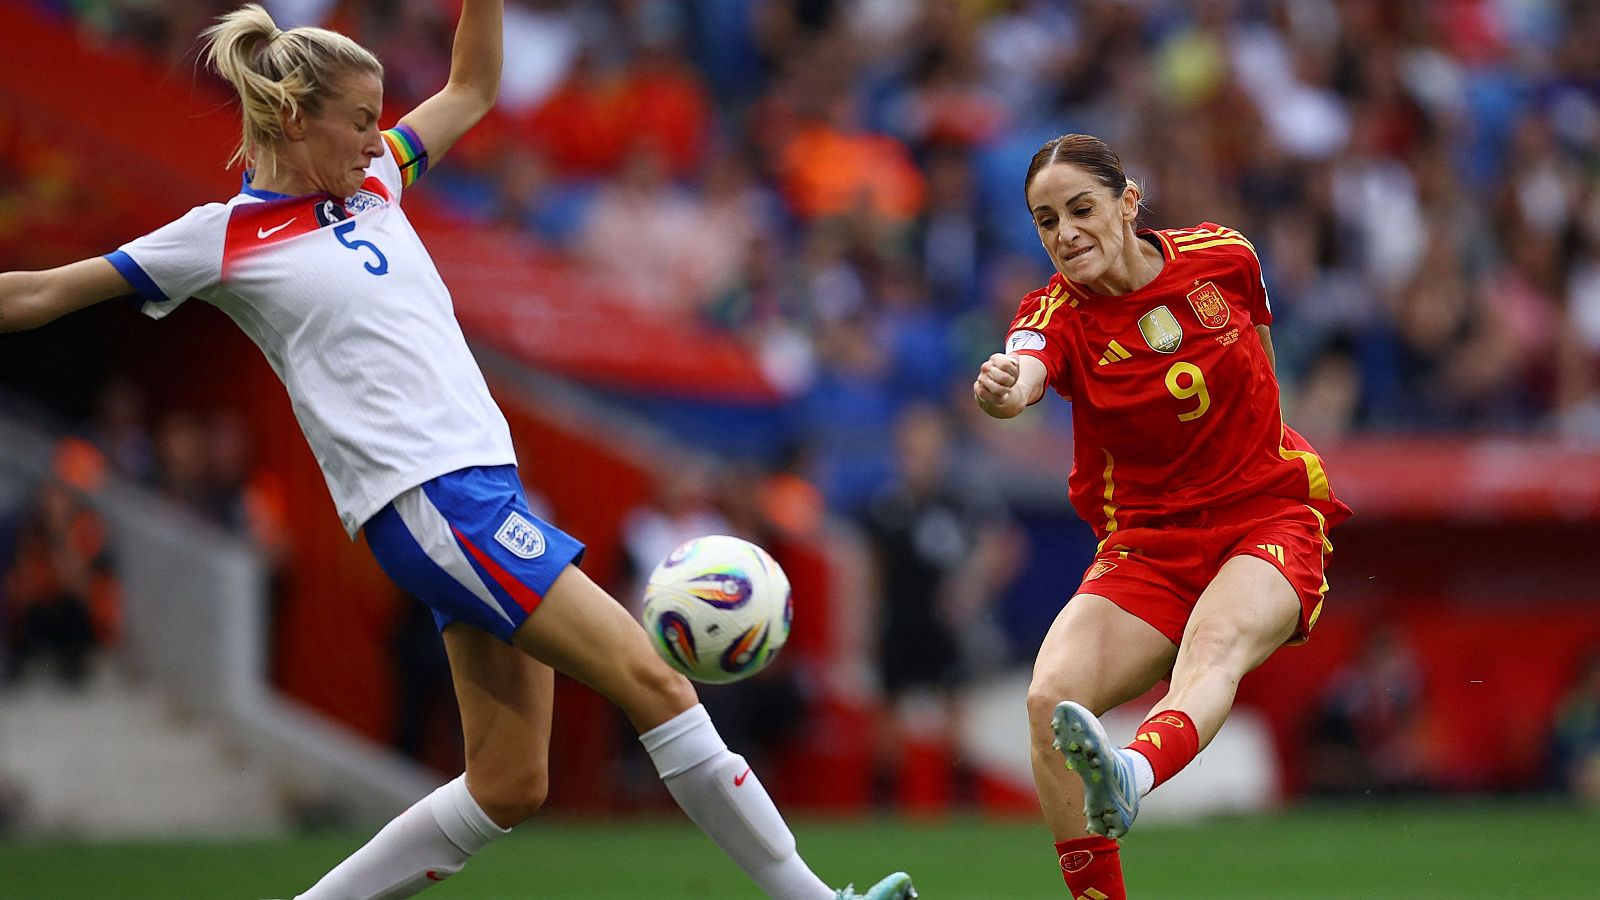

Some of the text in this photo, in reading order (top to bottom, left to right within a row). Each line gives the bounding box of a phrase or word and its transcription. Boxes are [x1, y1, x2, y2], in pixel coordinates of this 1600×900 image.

[333, 220, 388, 276] 5
[1159, 335, 1175, 345] FIFA
[1165, 361, 1210, 422] 9
